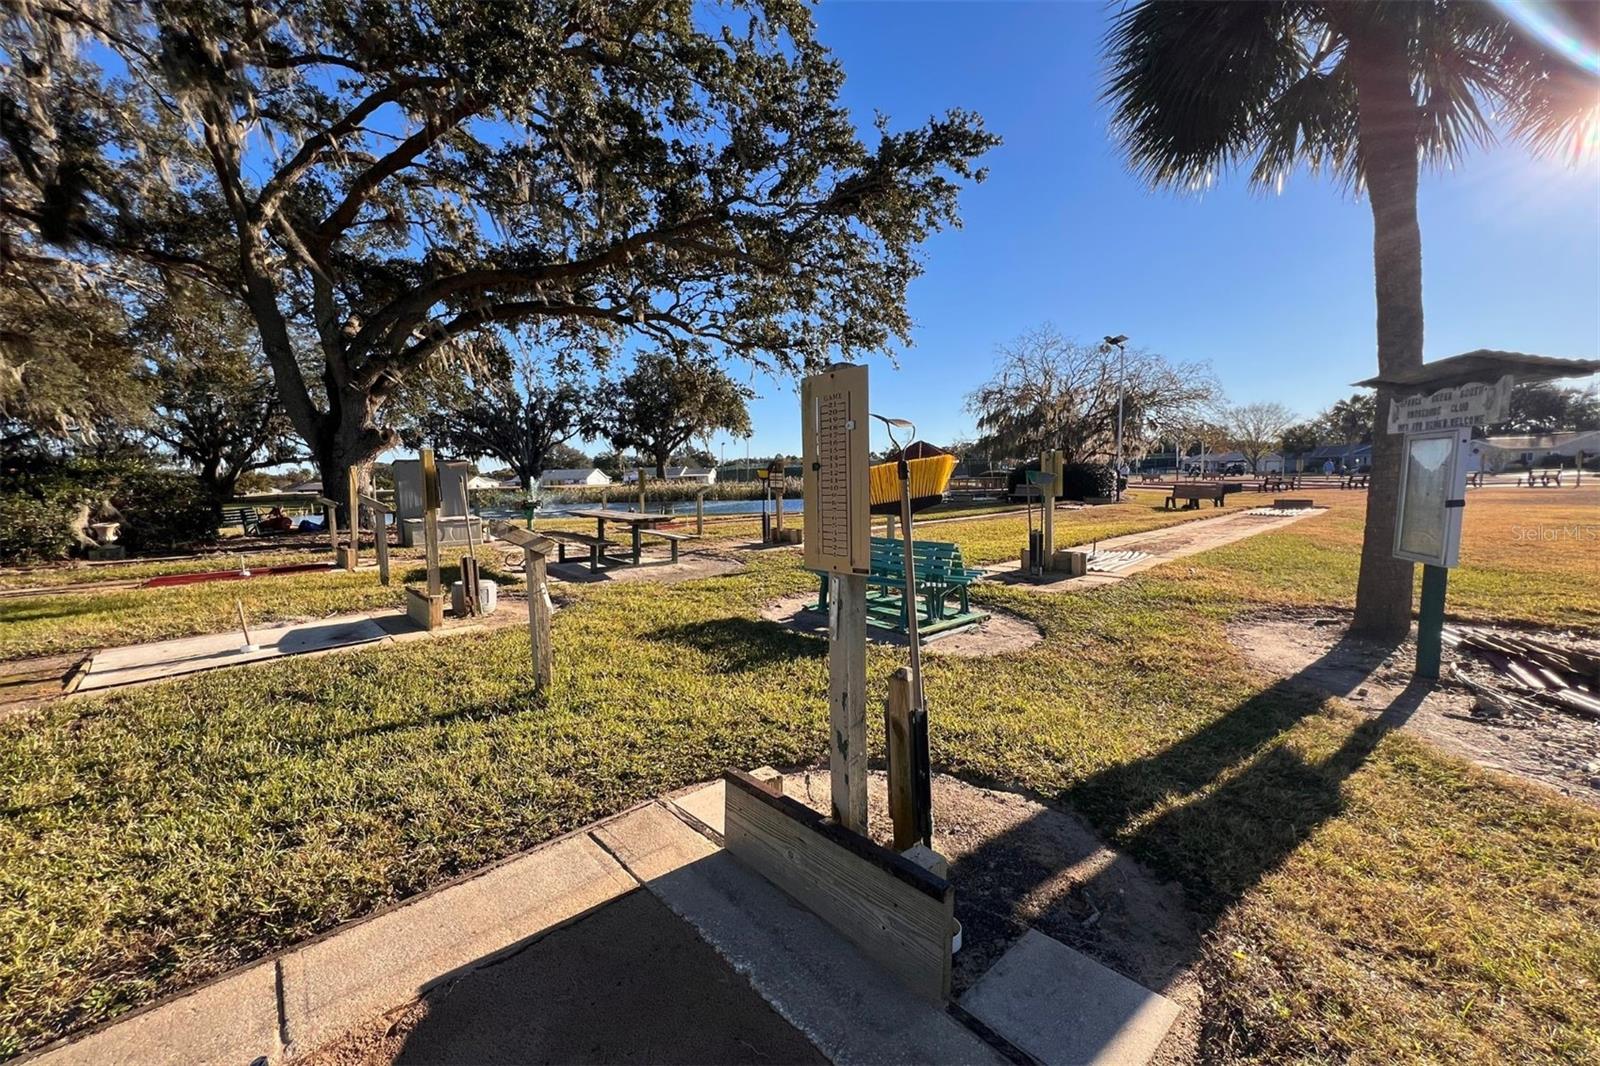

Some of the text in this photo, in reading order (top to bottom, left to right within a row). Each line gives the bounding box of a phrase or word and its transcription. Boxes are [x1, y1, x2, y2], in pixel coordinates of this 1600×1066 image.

[824, 392, 842, 402] GAME
[1450, 402, 1470, 412] CLUB
[1450, 414, 1486, 428] WELCOME
